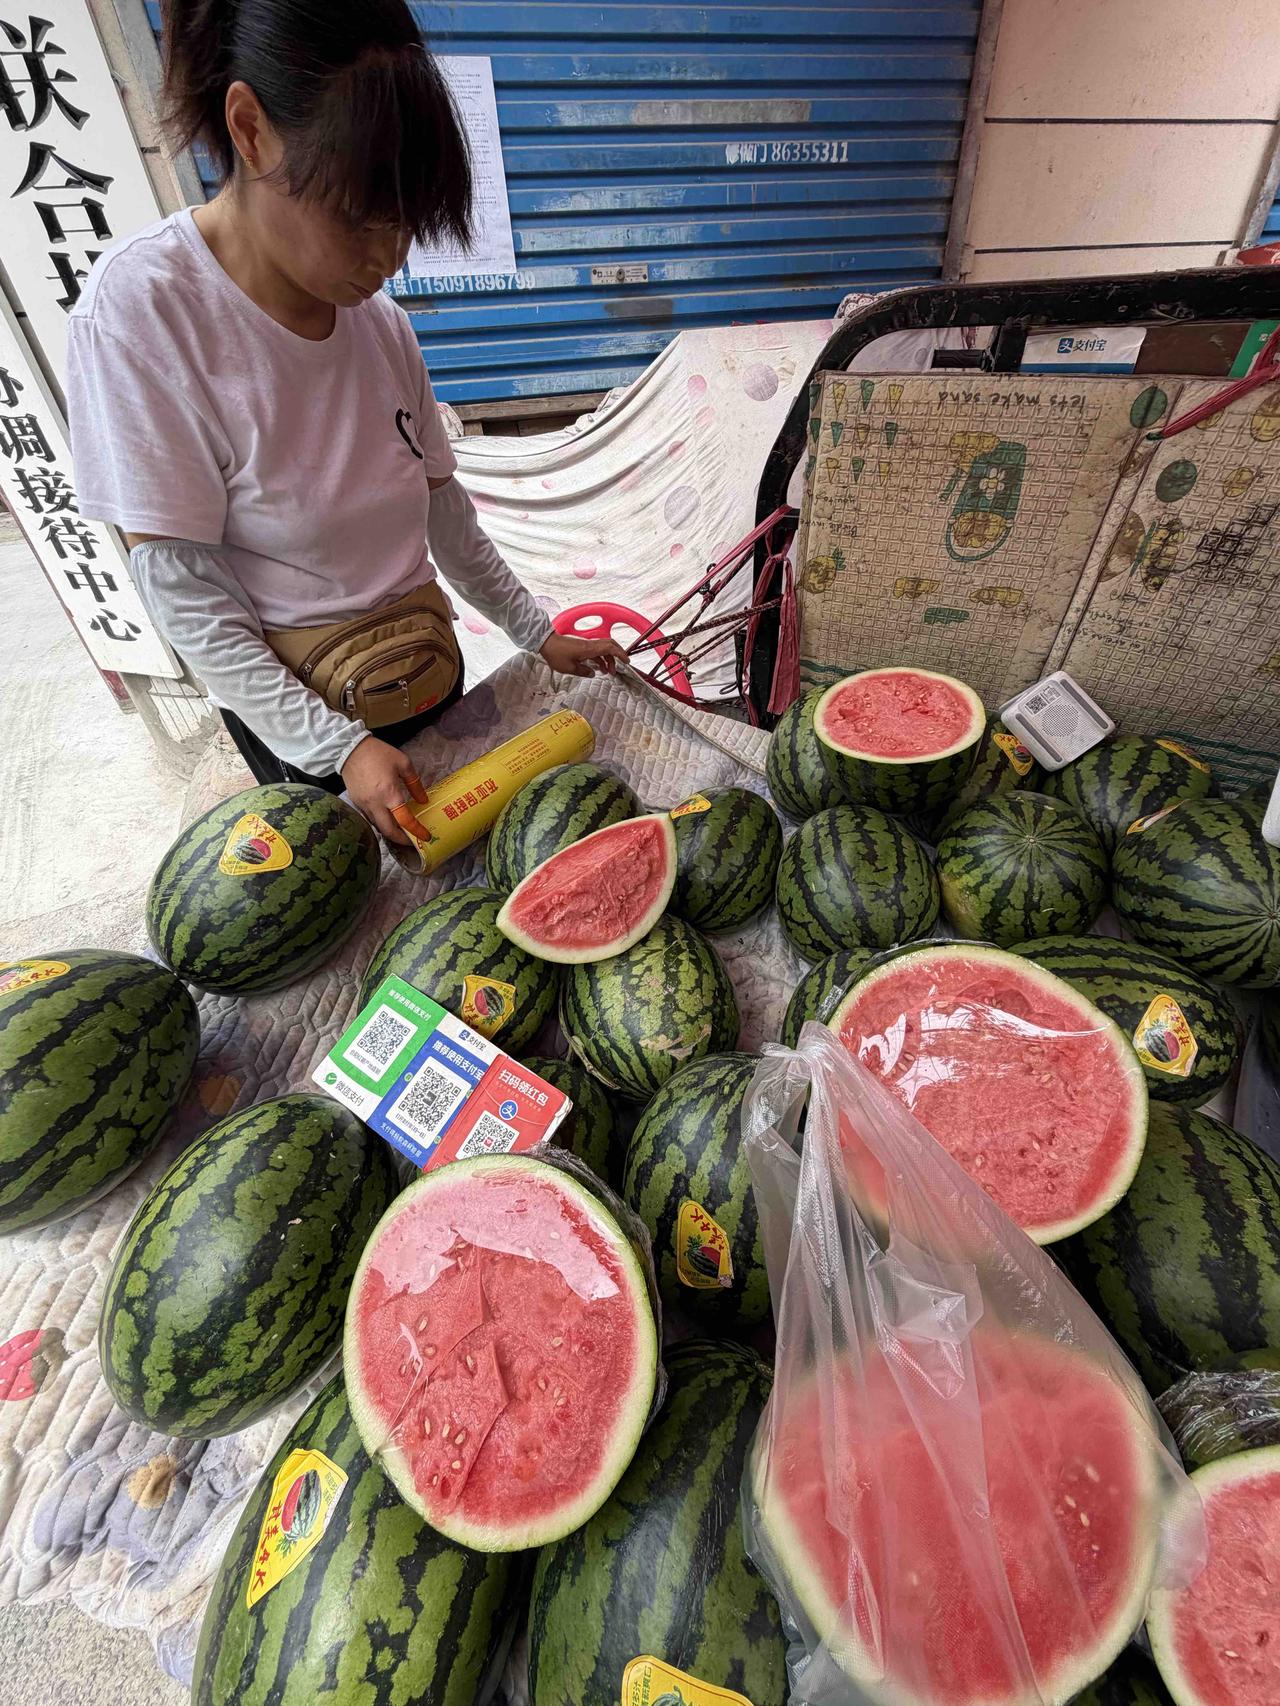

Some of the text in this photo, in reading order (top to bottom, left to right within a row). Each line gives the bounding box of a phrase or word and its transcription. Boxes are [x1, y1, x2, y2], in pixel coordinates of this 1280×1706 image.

[771, 142, 848, 162] 86355311
[1073, 338, 1107, 352] 支付宝
[990, 391, 1041, 409] make
[468, 1035, 488, 1052] 支付宝
[432, 1039, 487, 1080] 推荐使用支付宝
[335, 1079, 365, 1108] 微信支付
[497, 1068, 550, 1106] 扫码领红包
